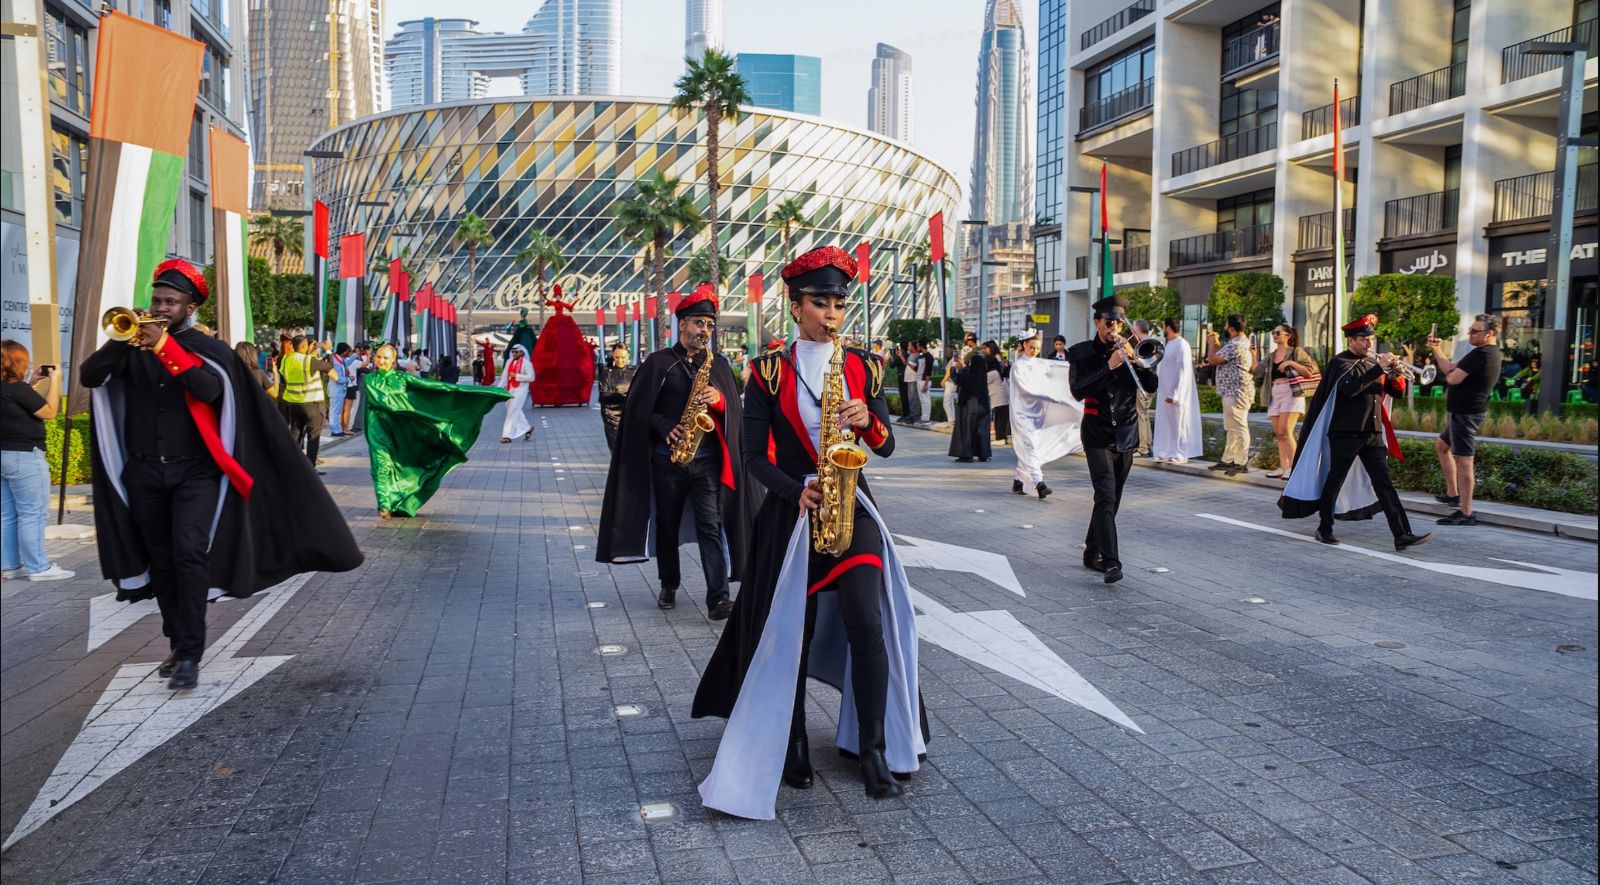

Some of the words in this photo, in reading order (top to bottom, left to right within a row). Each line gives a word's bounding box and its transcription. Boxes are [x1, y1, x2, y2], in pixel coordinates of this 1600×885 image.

[1502, 248, 1547, 266] THE
[1569, 242, 1598, 260] AT
[495, 273, 608, 310] CocaCola
